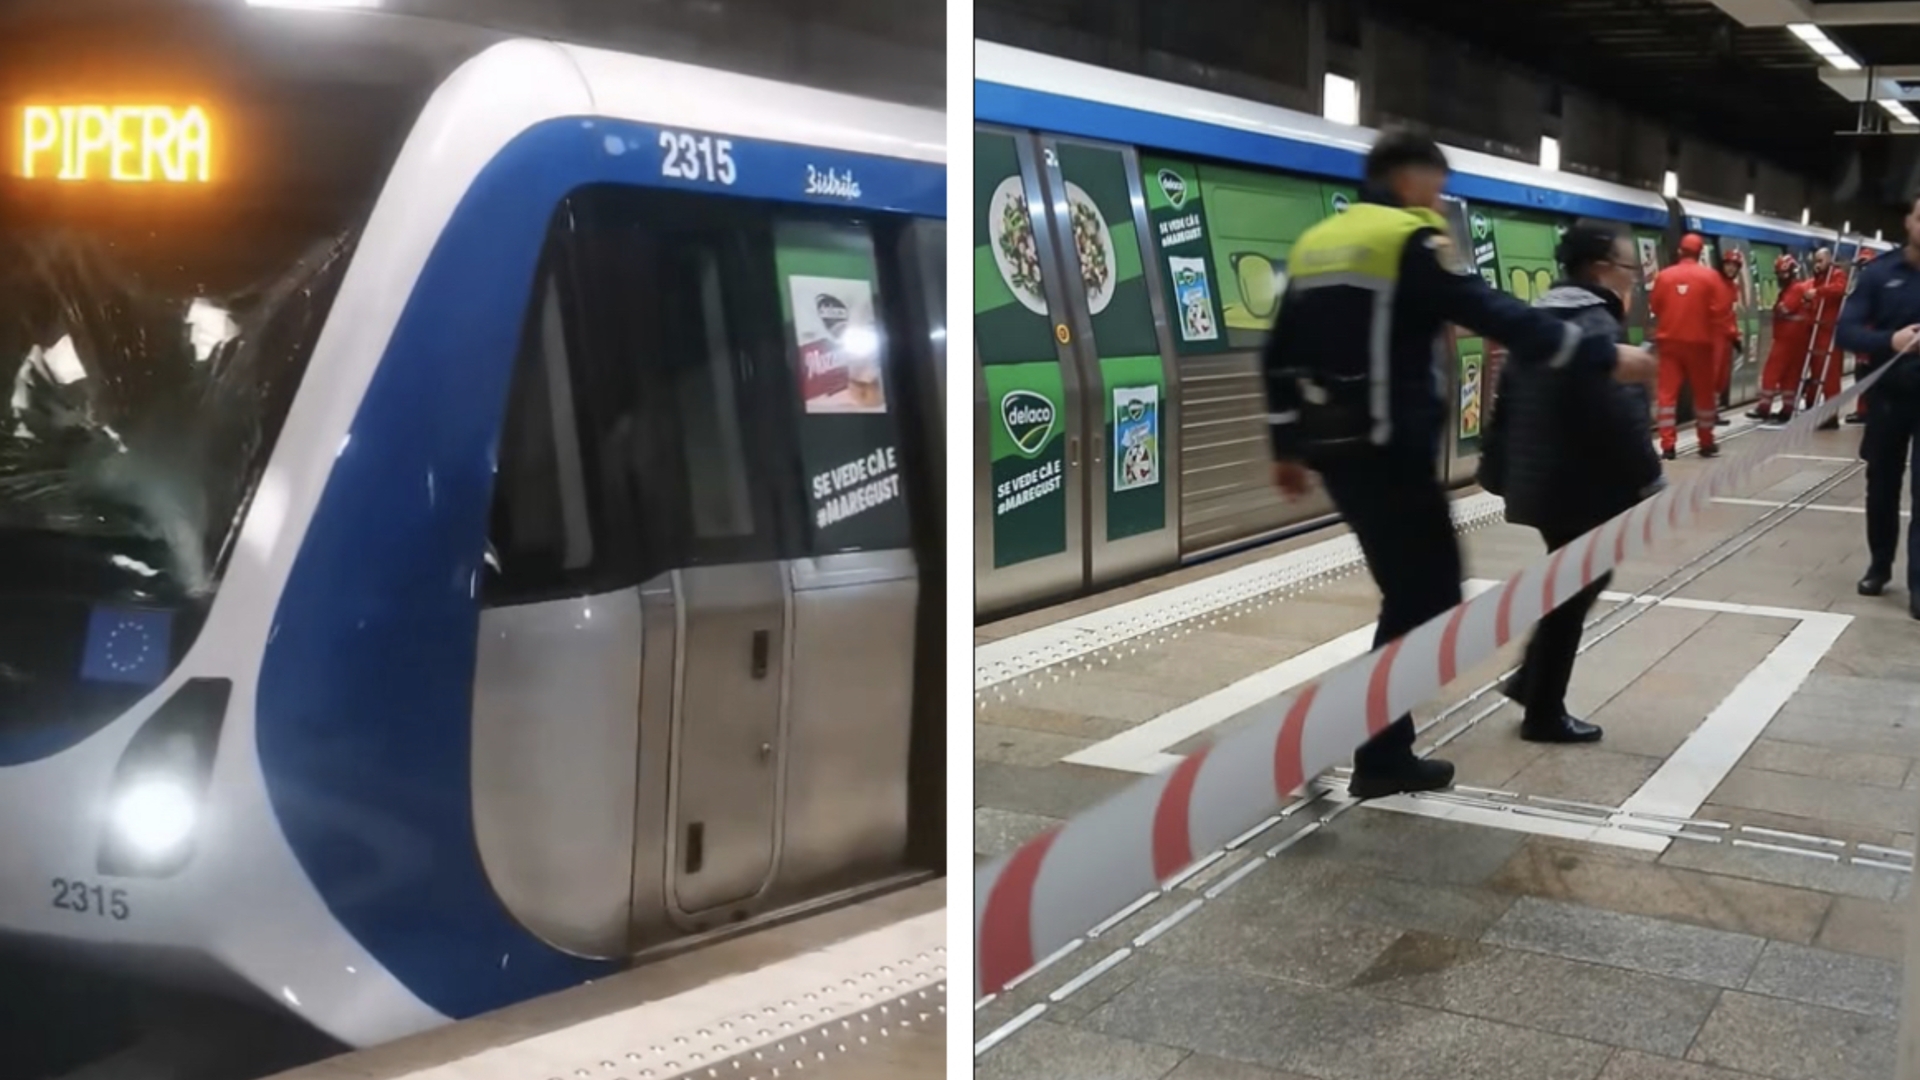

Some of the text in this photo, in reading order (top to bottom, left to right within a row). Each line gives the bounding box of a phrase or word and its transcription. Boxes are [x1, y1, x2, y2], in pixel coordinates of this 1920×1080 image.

[22, 105, 211, 182] PIPERA
[659, 131, 737, 186] 2315
[1008, 404, 1050, 426] delaco
[812, 471, 832, 500] SE
[831, 458, 868, 491] VEDE
[886, 446, 897, 469] E
[997, 480, 1011, 498] SE
[1011, 468, 1038, 492] VEDE
[1053, 459, 1061, 474] E
[997, 475, 1062, 515] #MAREGUST
[816, 474, 899, 529] #MAREGUST
[51, 877, 129, 920] 2315
